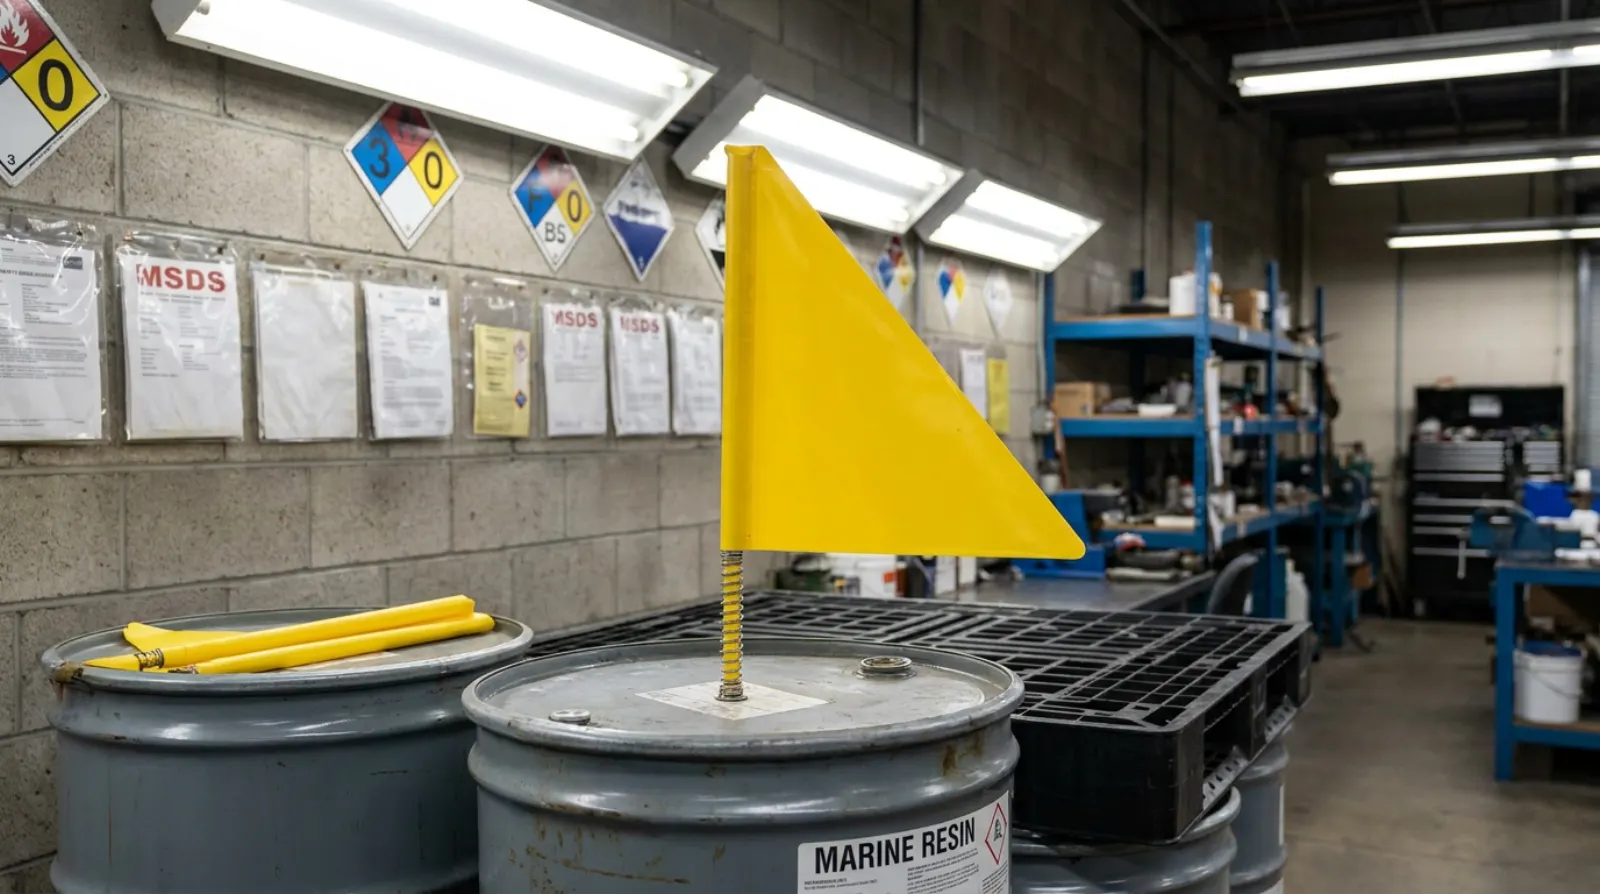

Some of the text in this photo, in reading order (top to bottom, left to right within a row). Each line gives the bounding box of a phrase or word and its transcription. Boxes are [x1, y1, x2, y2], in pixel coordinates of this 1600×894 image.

[38, 59, 74, 112] 0
[7, 154, 16, 165] 3
[369, 137, 391, 179] 3
[424, 151, 443, 189] 0
[567, 190, 582, 223] 0
[136, 263, 226, 292] MSDS
[815, 835, 914, 874] MARINE
[922, 817, 975, 858] RESIN
